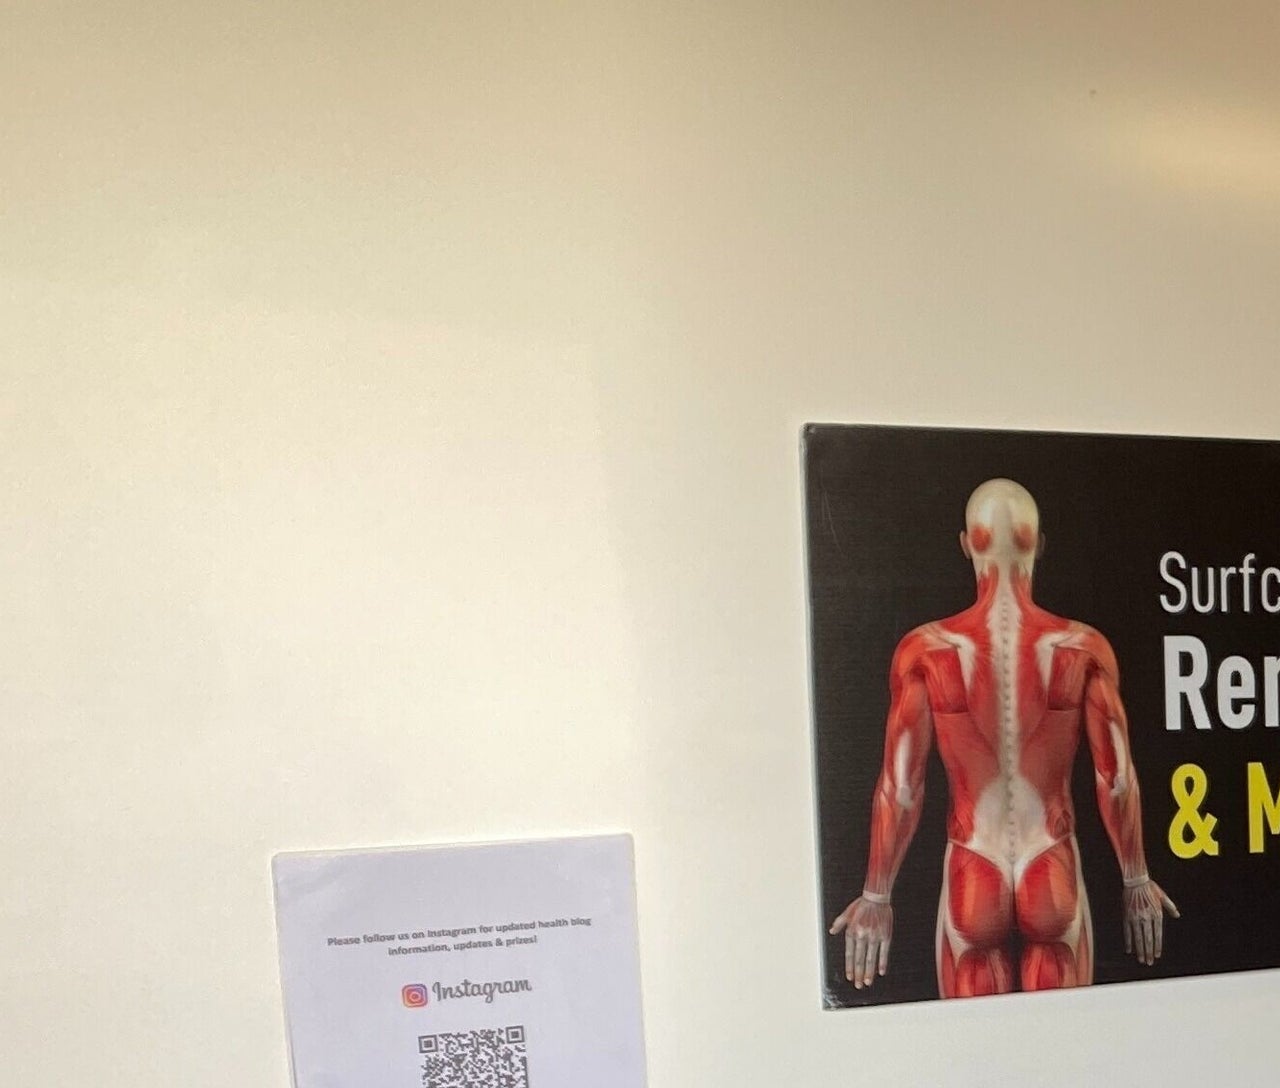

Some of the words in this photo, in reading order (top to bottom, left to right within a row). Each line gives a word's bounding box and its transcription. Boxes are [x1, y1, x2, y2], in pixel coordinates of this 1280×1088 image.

[1168, 763, 1219, 859] &
[327, 936, 361, 947] Please
[362, 933, 395, 944] follow
[398, 931, 409, 941] us
[411, 930, 425, 940] on
[427, 927, 477, 938] Instagram
[479, 924, 493, 935] for
[495, 921, 536, 933] updated
[538, 918, 569, 928] health
[570, 917, 592, 927] blog
[388, 942, 451, 956] information,
[453, 939, 493, 951] updates
[495, 937, 504, 947] &
[505, 935, 538, 948] prizes!
[431, 977, 532, 1004] Instagram
